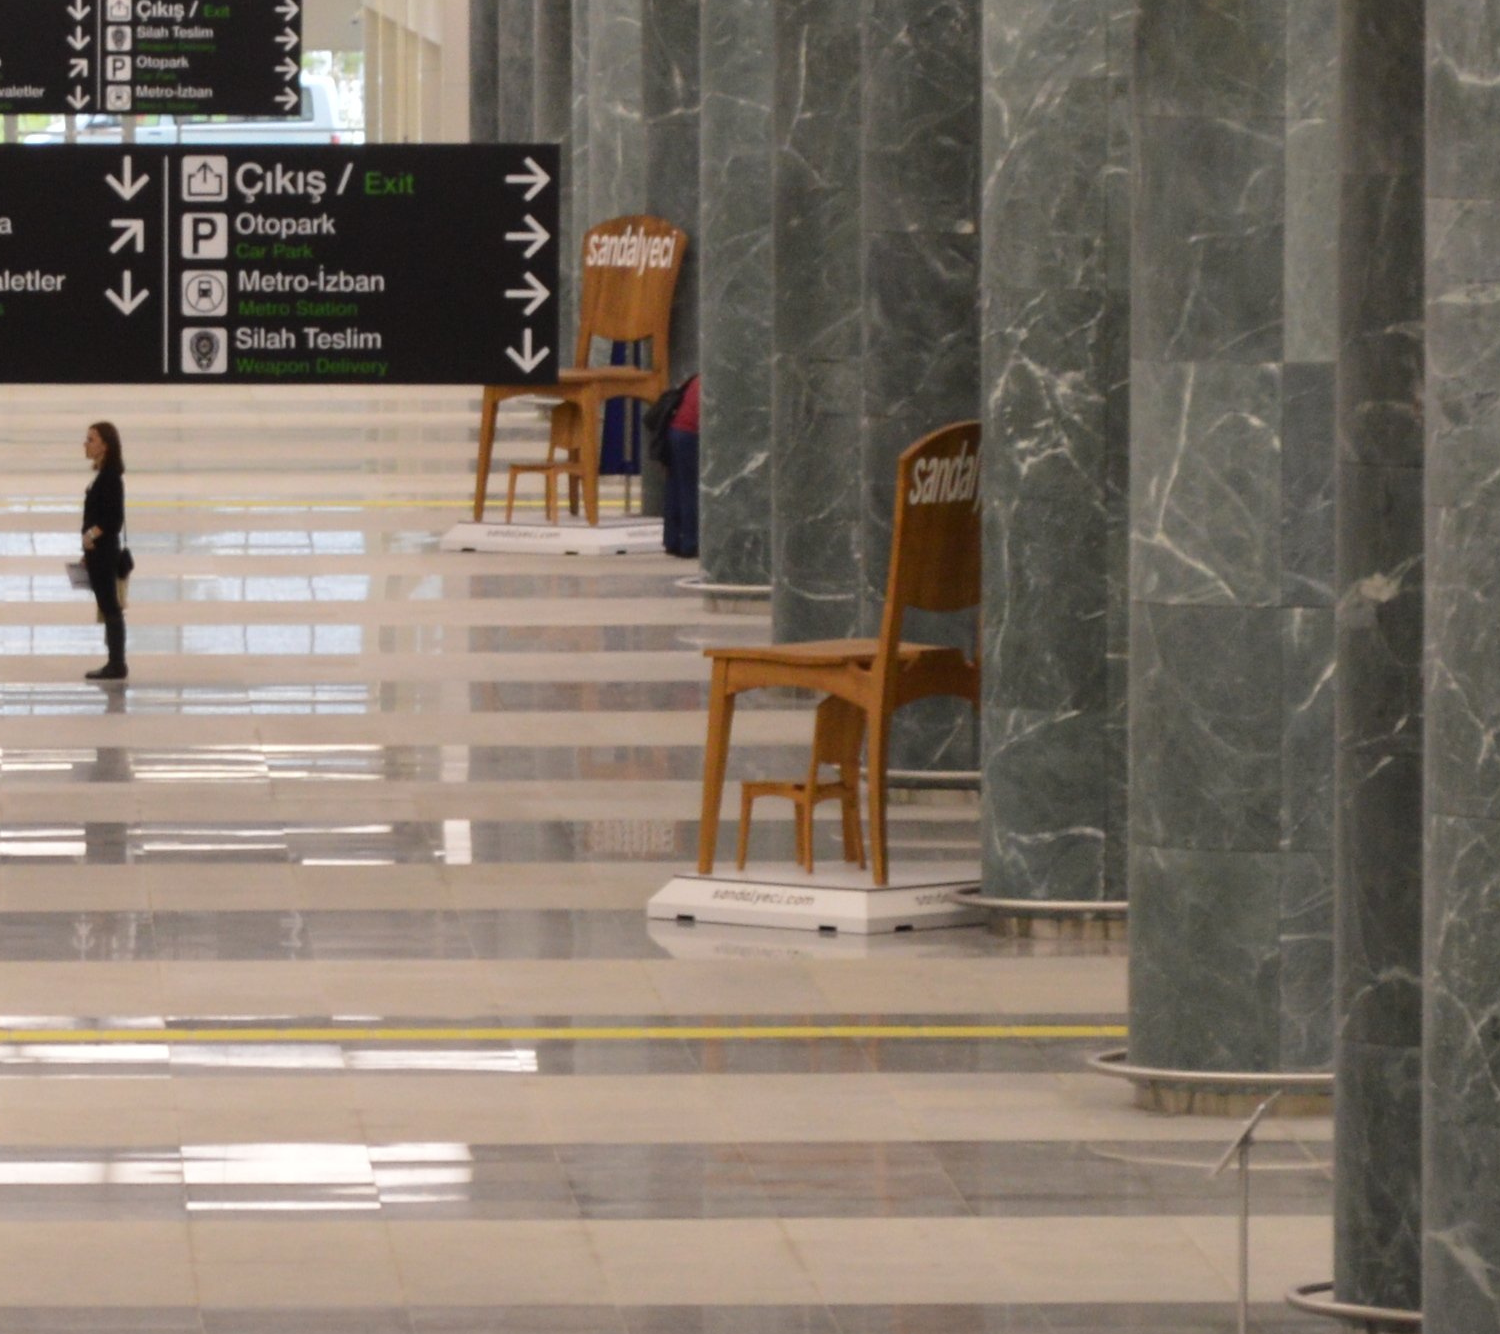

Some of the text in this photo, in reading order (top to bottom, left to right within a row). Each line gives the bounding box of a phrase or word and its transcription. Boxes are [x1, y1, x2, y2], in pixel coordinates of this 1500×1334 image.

[136, 0, 185, 22] Çıkış
[136, 26, 214, 38] Silah Teslim
[136, 56, 189, 69] Otopark
[235, 162, 327, 204] Çıkış
[364, 171, 415, 195] Exit
[235, 213, 336, 238] Otopark
[236, 243, 314, 259] Car Park
[586, 224, 678, 277] sandalyeci
[238, 265, 385, 292] Metro-İzban
[238, 301, 358, 316] Metro Station
[235, 327, 382, 350] Silah Teslim
[237, 358, 388, 376] Weapon Delivery
[908, 440, 981, 513] sandal
